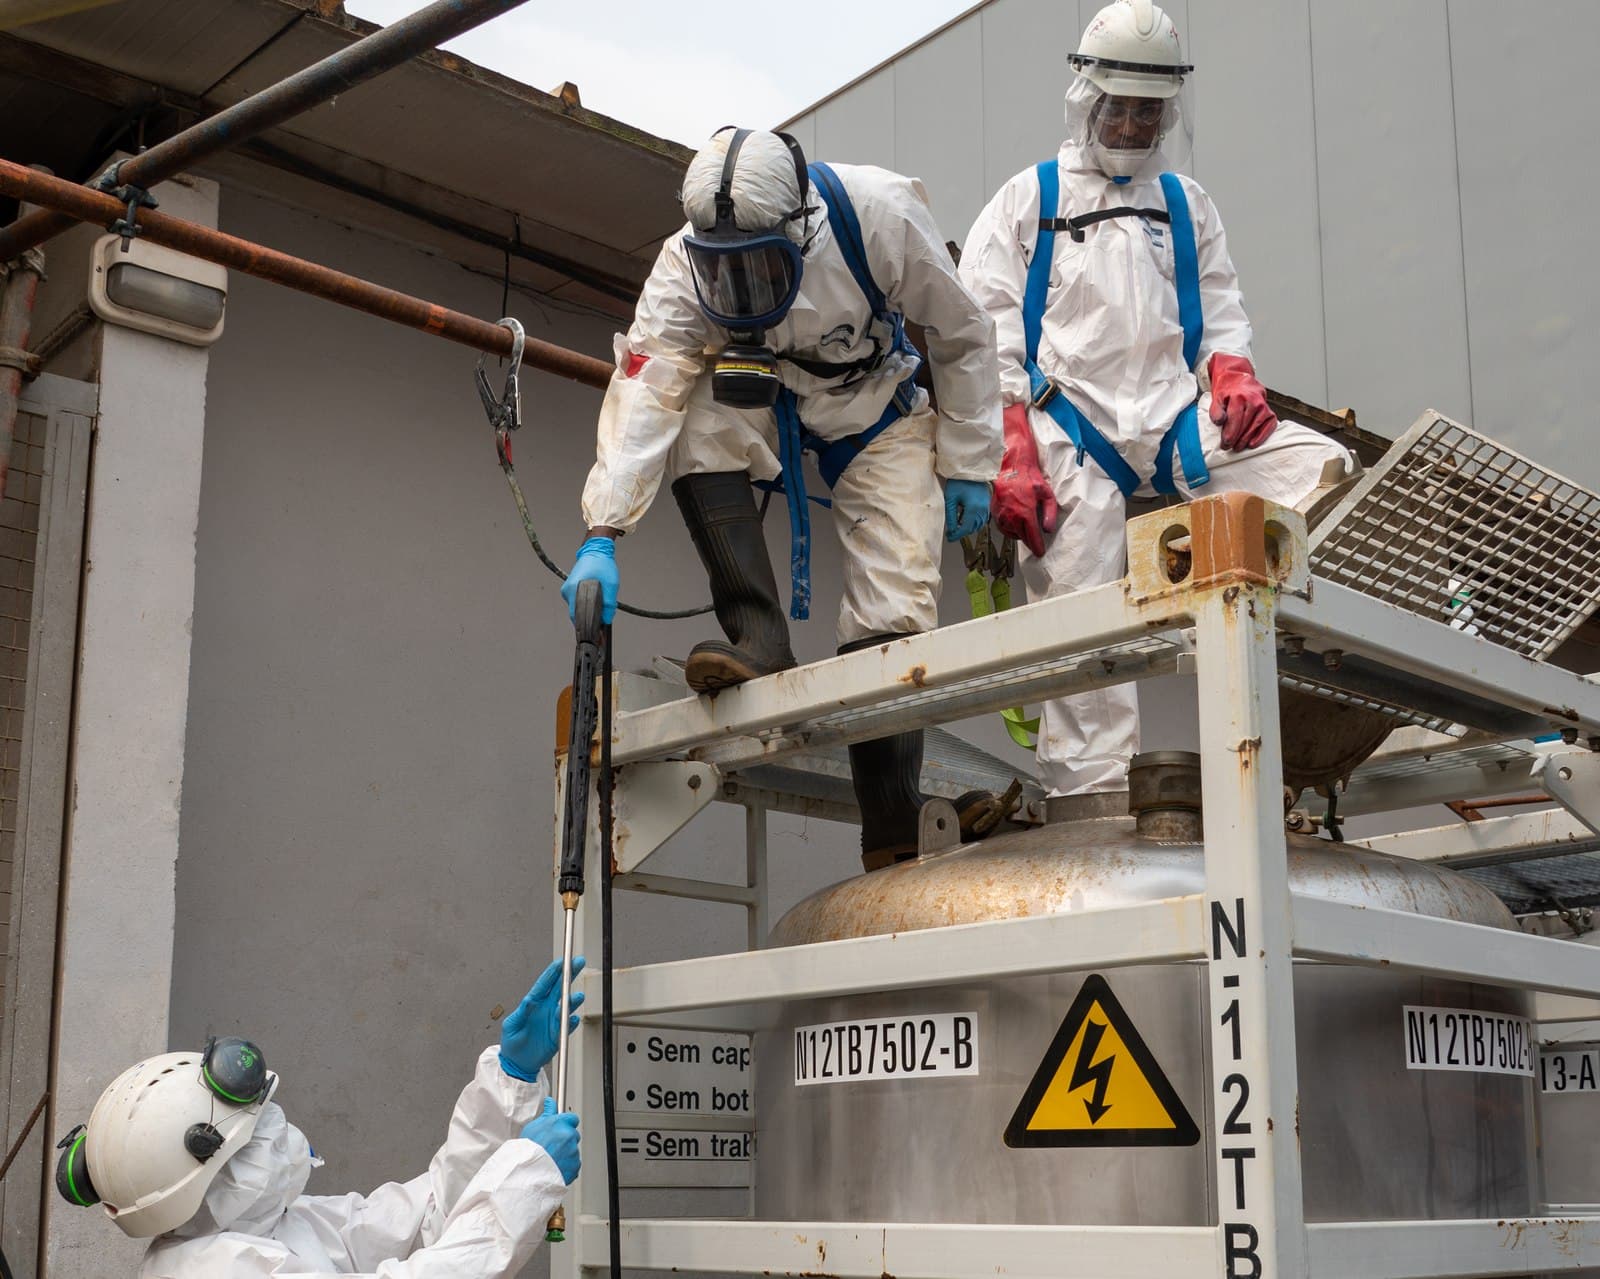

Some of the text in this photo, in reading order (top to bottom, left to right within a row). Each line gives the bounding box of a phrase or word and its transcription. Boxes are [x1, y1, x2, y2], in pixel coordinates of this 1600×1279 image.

[647, 1036, 701, 1063] Sem
[796, 1016, 973, 1080] N12TB7502-B
[1407, 1010, 1534, 1071] N12TB7502-B
[646, 1083, 750, 1111] Sem bot
[645, 1131, 699, 1157] Sem
